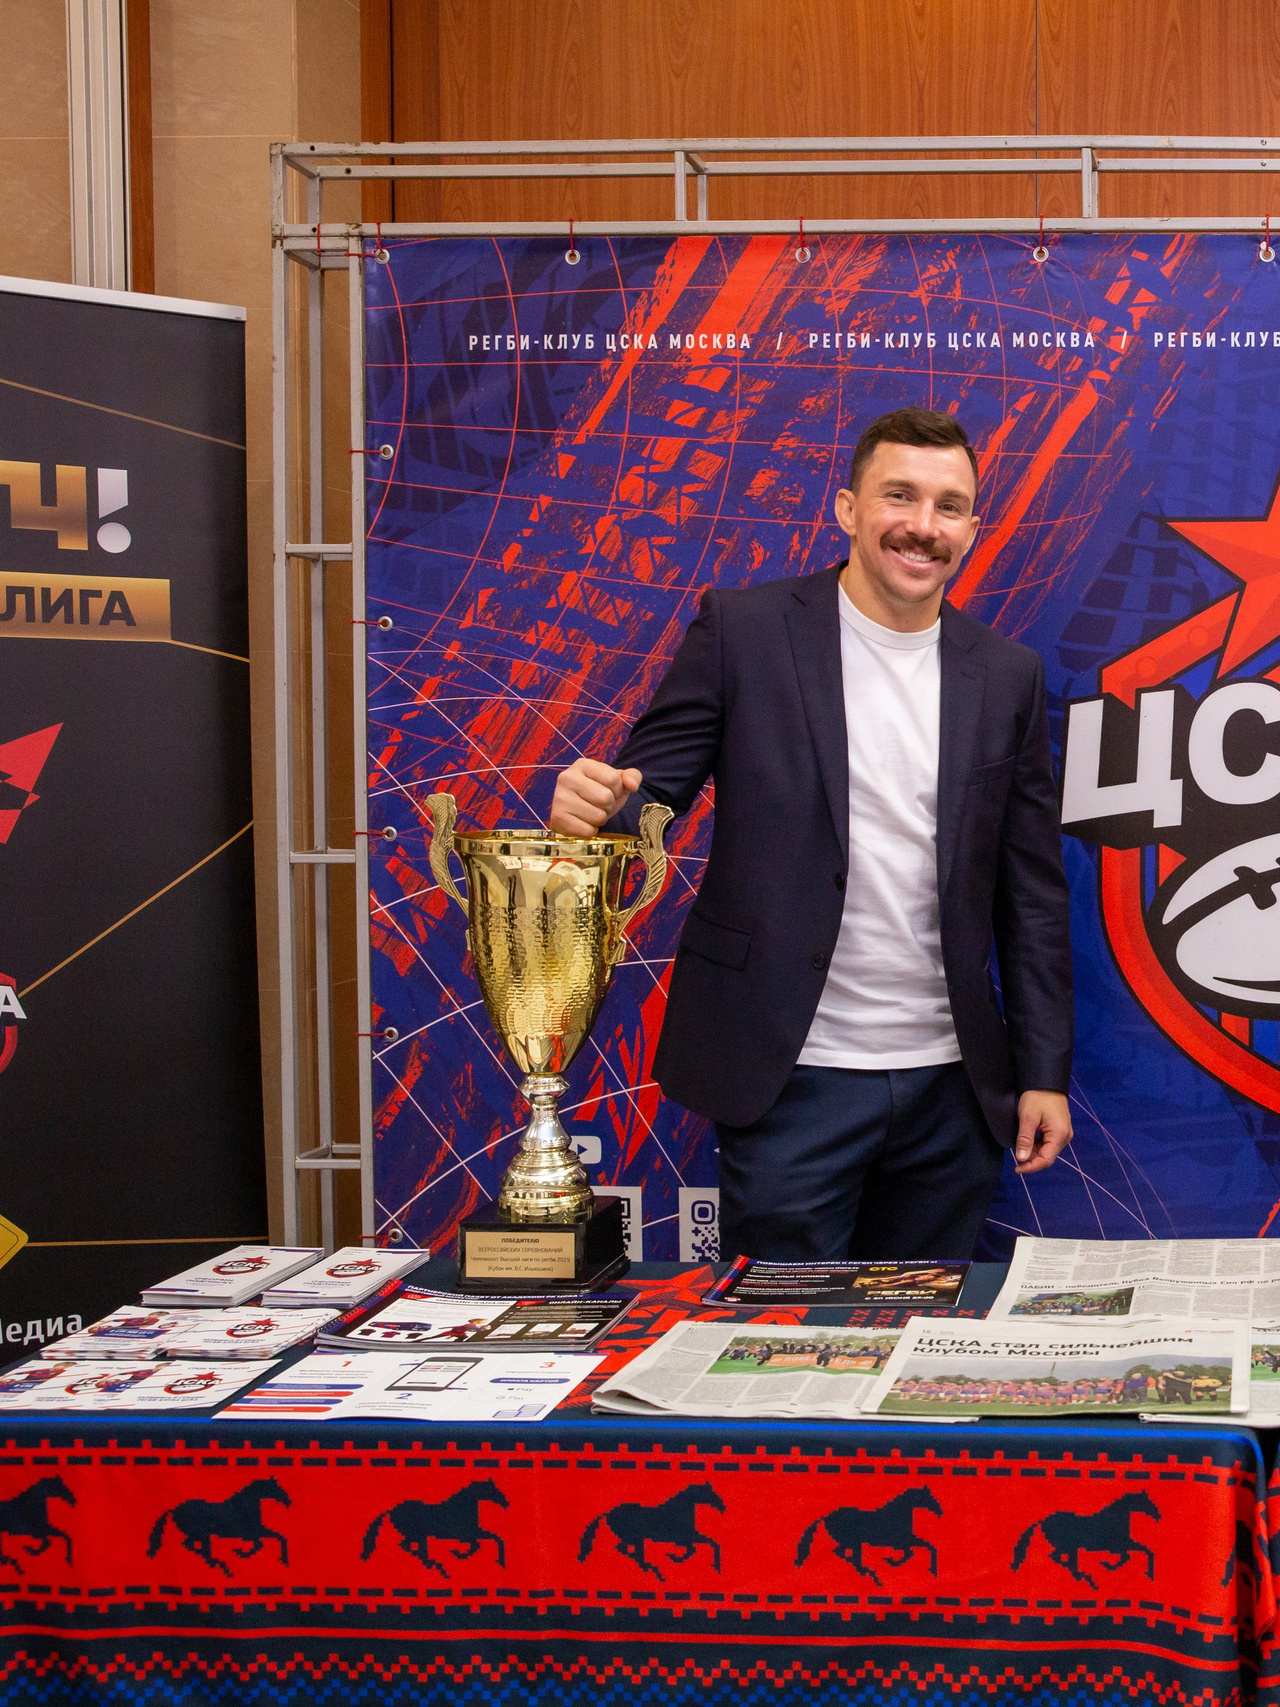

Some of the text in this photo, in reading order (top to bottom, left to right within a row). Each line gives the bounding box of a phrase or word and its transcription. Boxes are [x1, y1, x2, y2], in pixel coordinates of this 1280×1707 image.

[469, 333, 595, 351] РЕГБИ-КЛУБ
[606, 333, 658, 353] ЦСКА
[669, 333, 751, 350] МОСКВА
[809, 332, 937, 349] РЕГБИ-КЛУБ
[948, 332, 1001, 351] ЦСКА
[1012, 331, 1095, 348] МОСКВА
[0, 1313, 83, 1346] едиа
[916, 1336, 1194, 1350] ЦСКА стал сильнейшим
[1006, 1348, 1100, 1357] Москвы
[341, 1360, 353, 1368] 1
[539, 1361, 556, 1369] 3
[394, 1392, 413, 1401] 2
